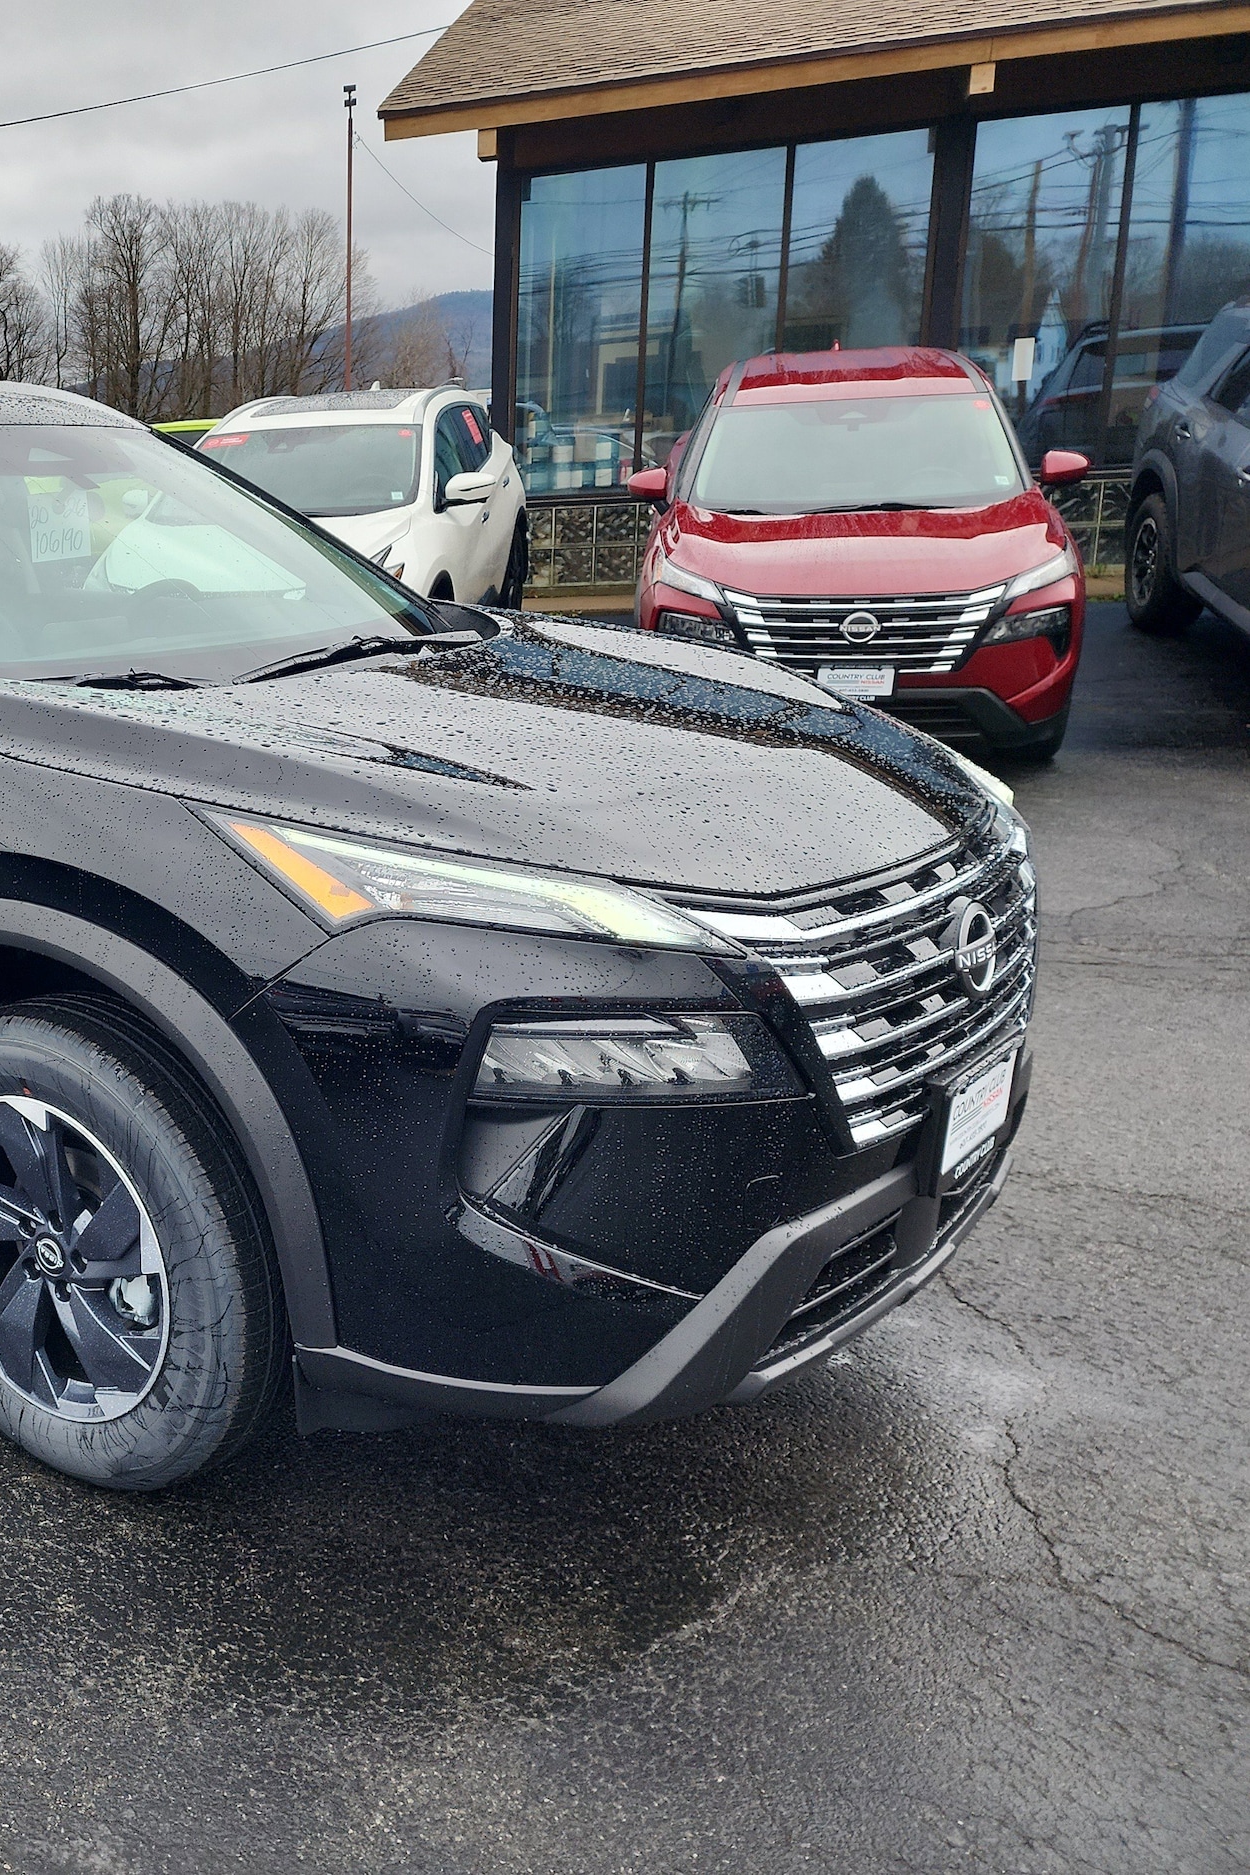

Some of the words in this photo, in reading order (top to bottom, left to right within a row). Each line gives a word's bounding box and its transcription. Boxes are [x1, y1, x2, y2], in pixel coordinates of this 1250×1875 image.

[30, 505, 49, 529] 20
[36, 528, 83, 559] 106190
[827, 673, 864, 681] COUNTRY
[959, 941, 997, 969] NISS
[953, 1085, 988, 1121] COUNTRY
[988, 1069, 1007, 1094] CLUB
[954, 1147, 982, 1180] COUNTRY
[980, 1135, 995, 1157] CLUB
